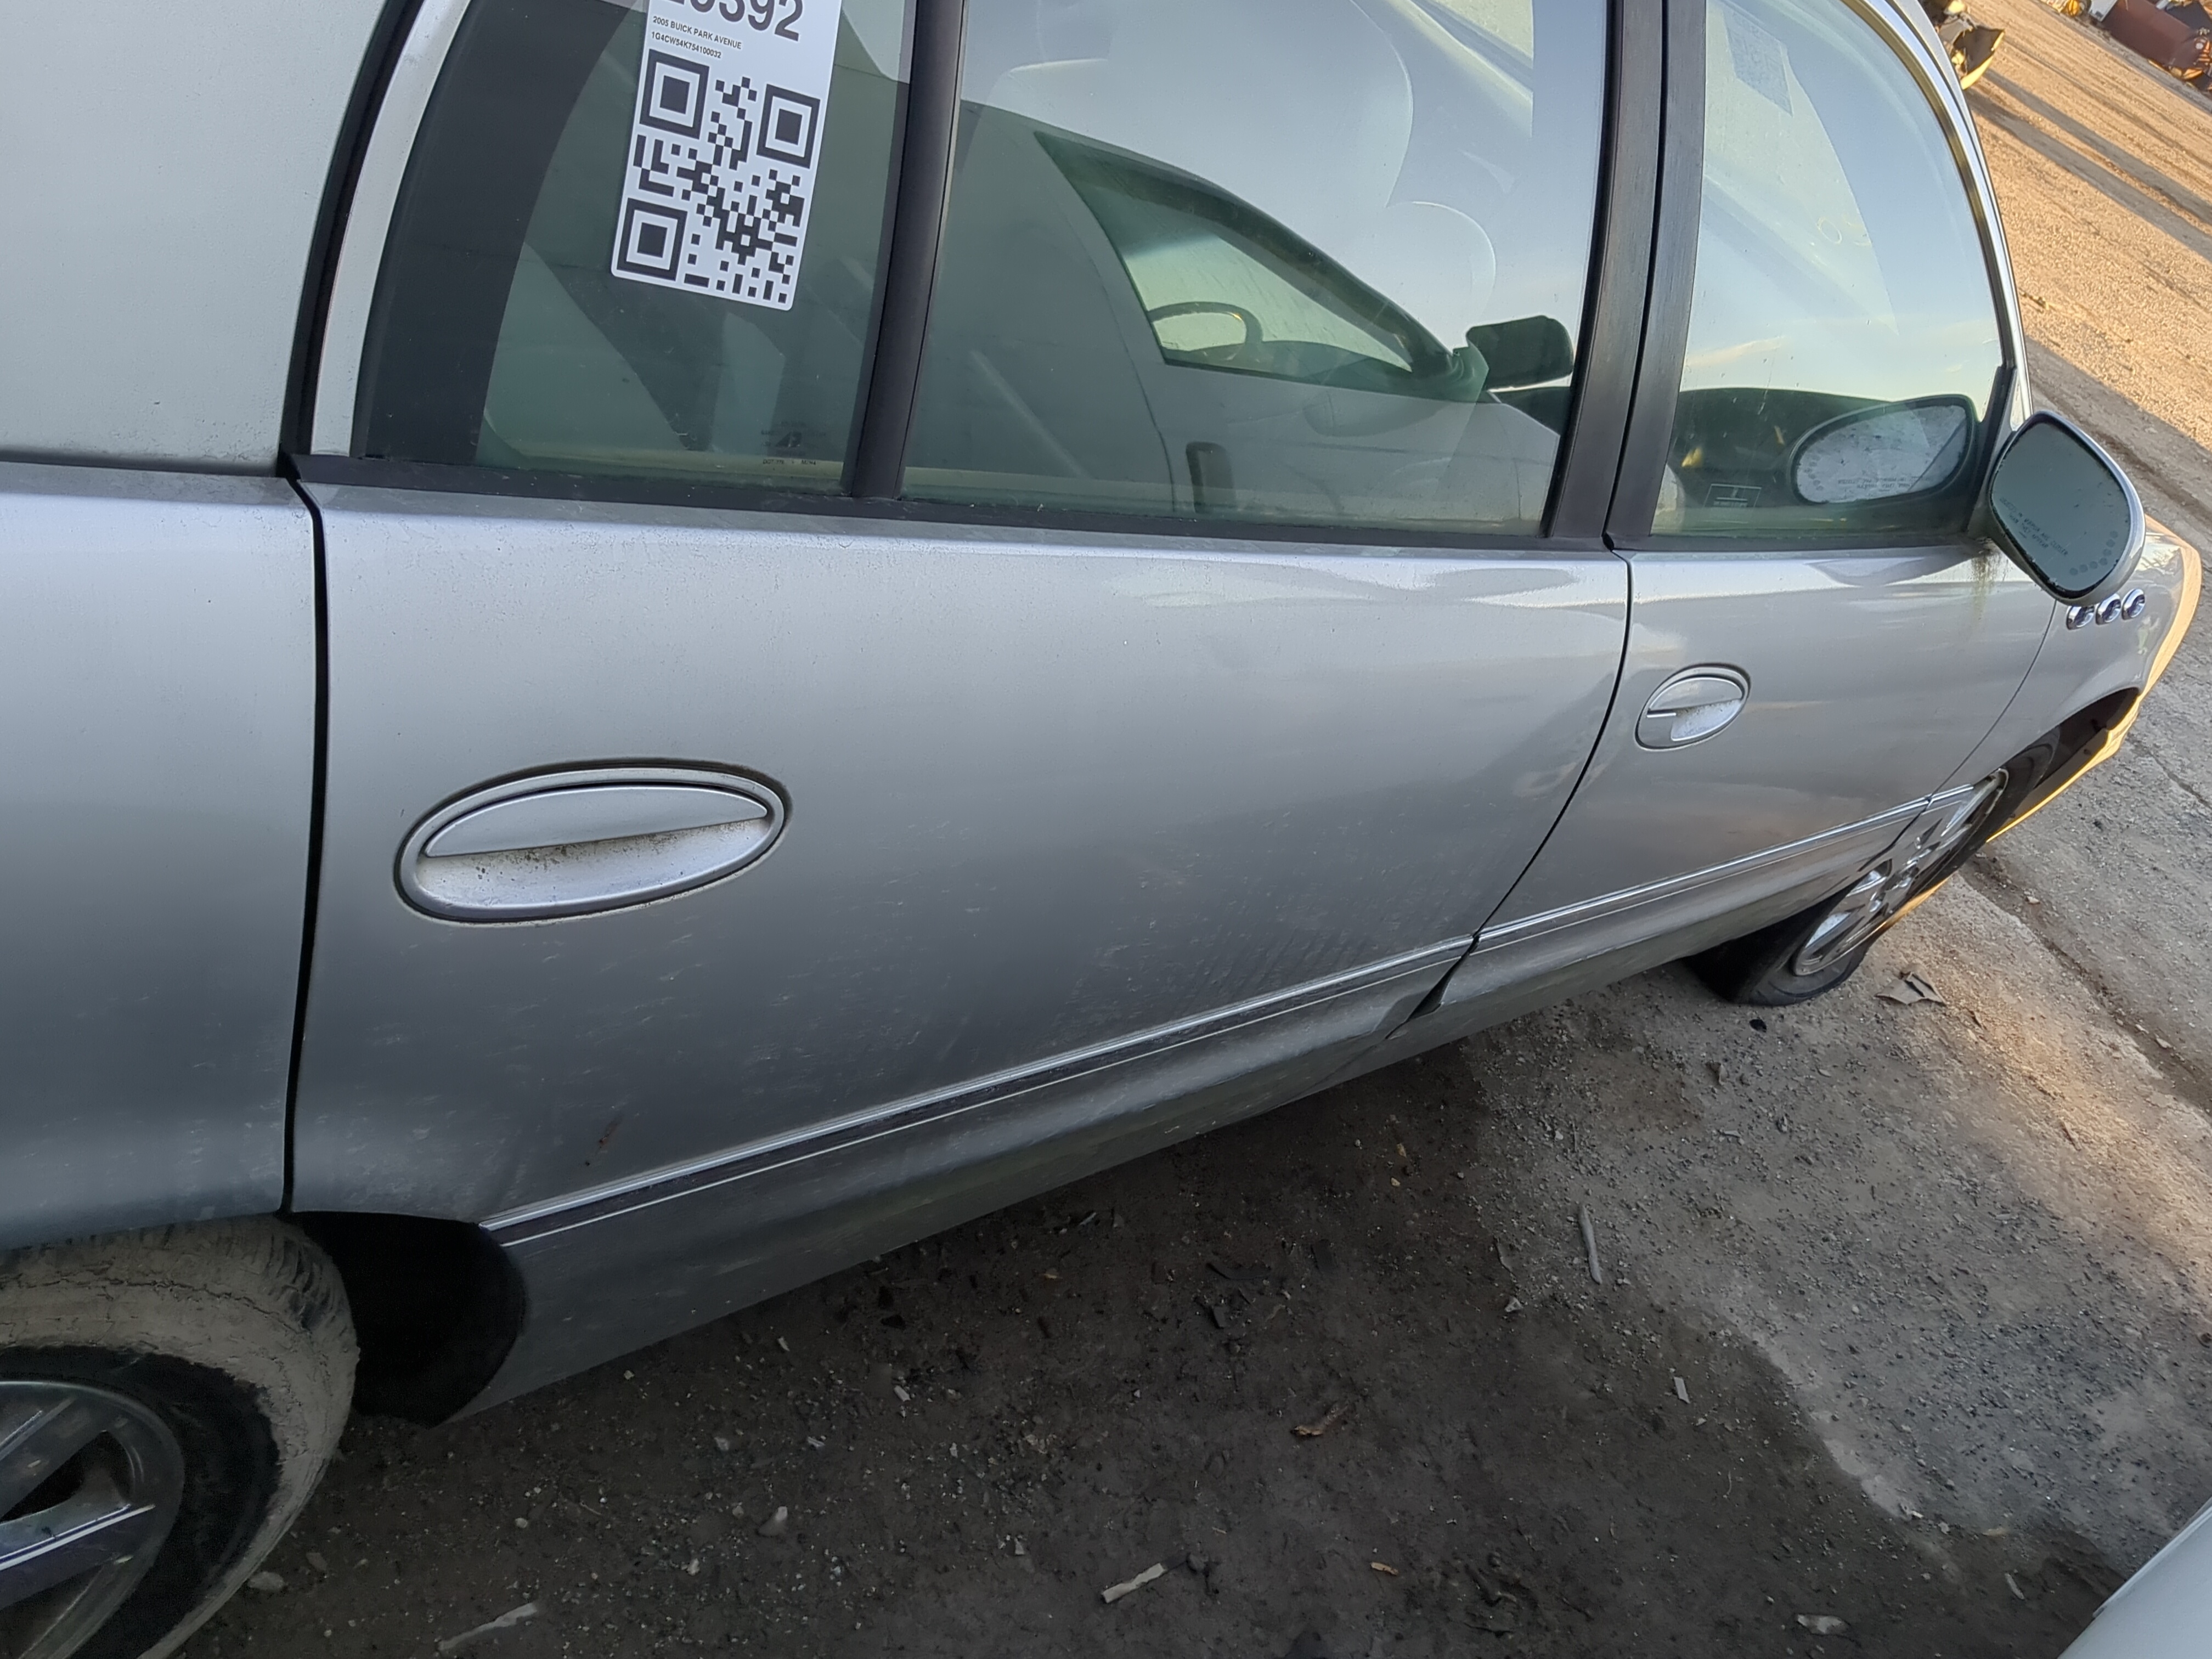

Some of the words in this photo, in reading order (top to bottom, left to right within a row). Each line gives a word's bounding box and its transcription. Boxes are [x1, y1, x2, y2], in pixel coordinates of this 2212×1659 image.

[652, 32, 721, 59] 1G4CW54K754100032
[653, 16, 669, 27] 2005
[671, 21, 692, 34] BUICK
[694, 29, 713, 41] PARK
[714, 35, 742, 49] AVENUE
